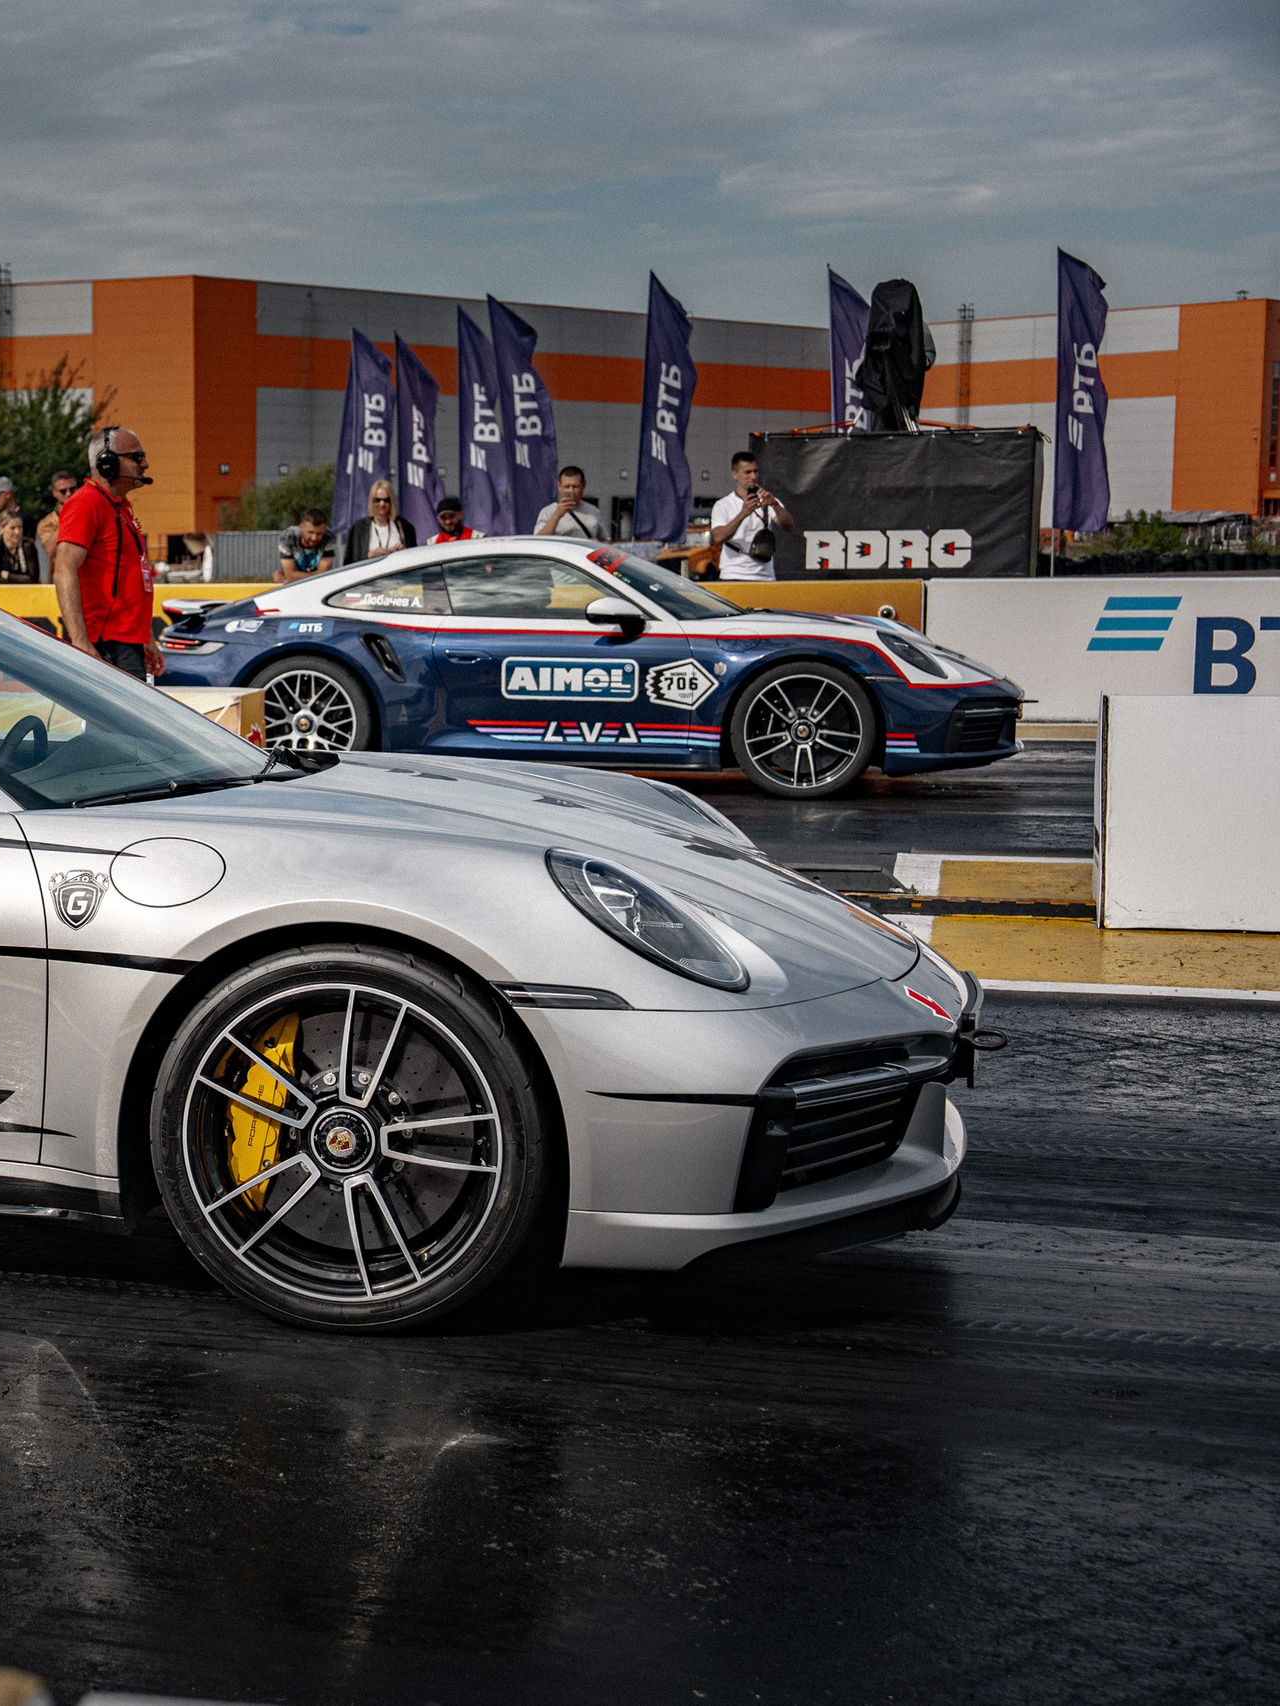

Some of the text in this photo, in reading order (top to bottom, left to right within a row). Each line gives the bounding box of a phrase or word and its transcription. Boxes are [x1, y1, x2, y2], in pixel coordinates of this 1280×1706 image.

[363, 393, 387, 447] ВТБ
[511, 372, 542, 436] ВТБ
[656, 362, 682, 434] ВТБ
[803, 529, 972, 569] RDRC
[298, 622, 323, 633] ВТБ
[1193, 616, 1280, 695] В
[663, 677, 699, 691] 706
